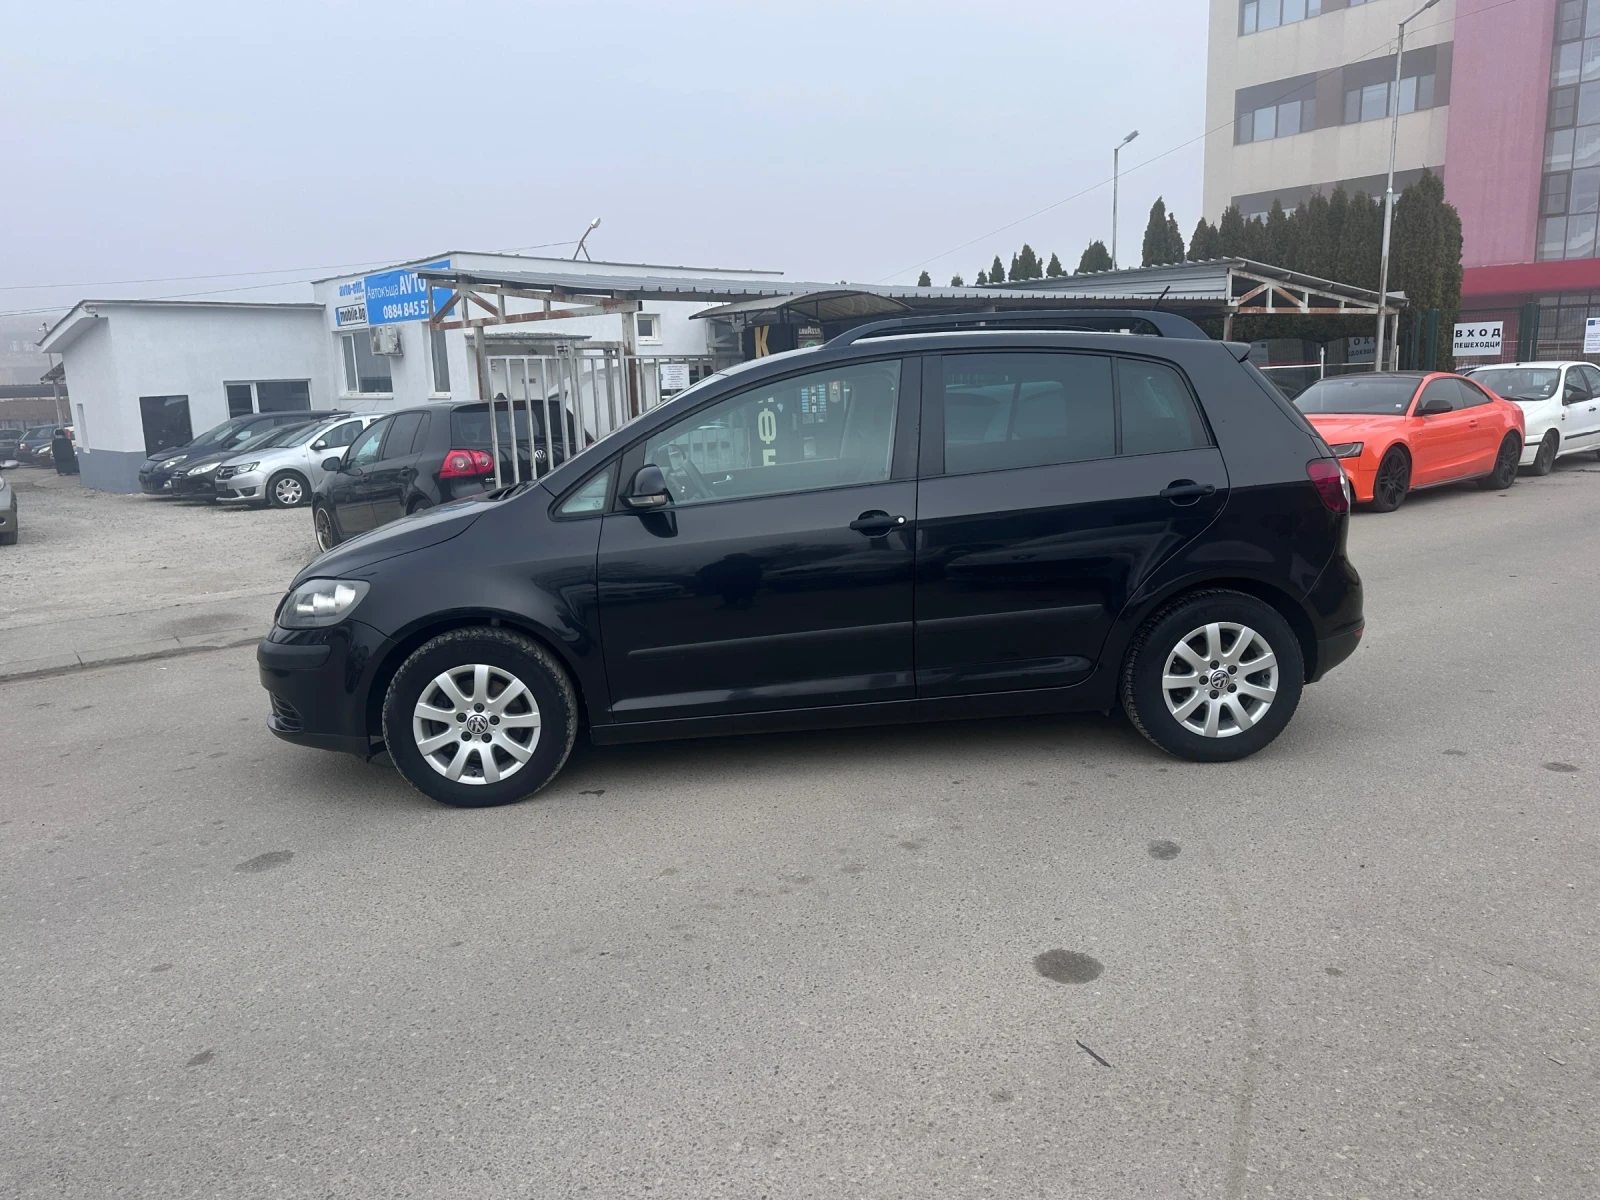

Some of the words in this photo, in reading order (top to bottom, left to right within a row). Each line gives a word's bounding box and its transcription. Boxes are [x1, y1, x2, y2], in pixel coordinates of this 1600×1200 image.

[367, 284, 399, 299] Автокъща
[340, 306, 366, 321] mobile.bg
[383, 304, 402, 319] 0884
[403, 301, 419, 316] 845
[1455, 328, 1501, 338] ВХОД
[1454, 341, 1500, 349] ПЕШЕХОДЦИ
